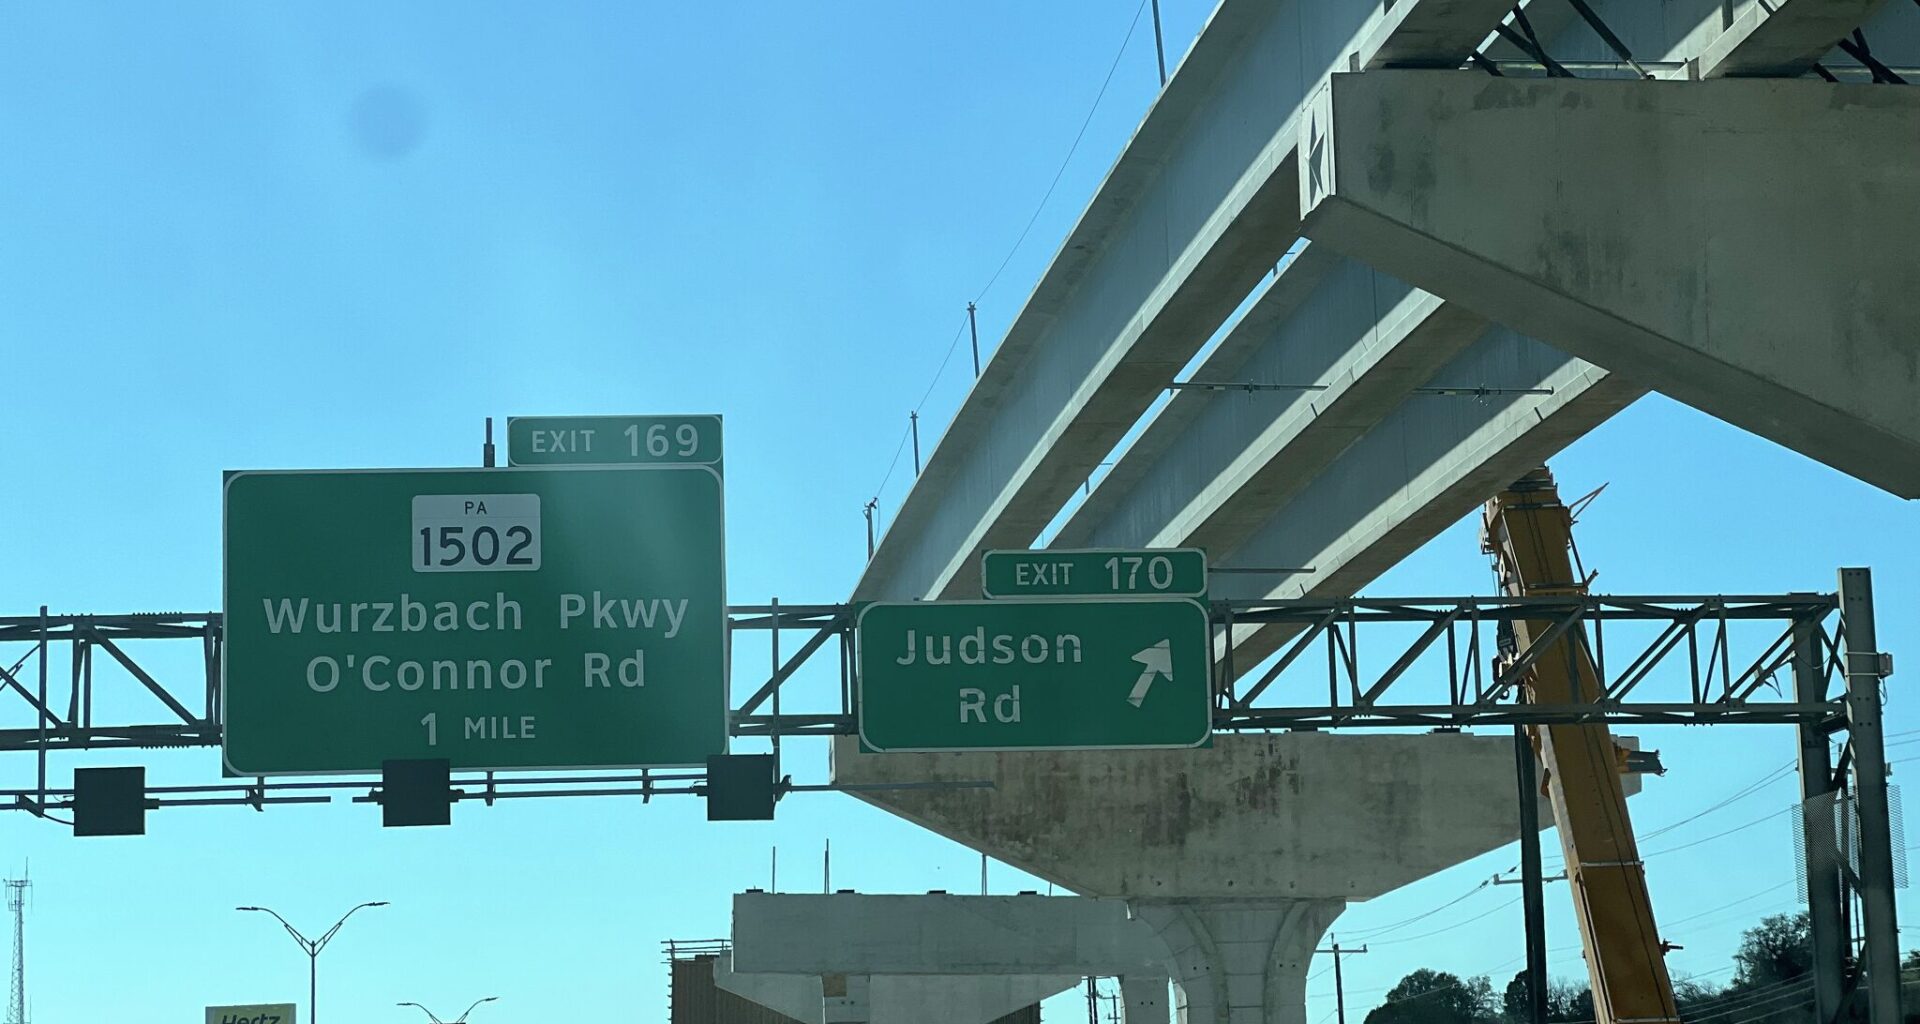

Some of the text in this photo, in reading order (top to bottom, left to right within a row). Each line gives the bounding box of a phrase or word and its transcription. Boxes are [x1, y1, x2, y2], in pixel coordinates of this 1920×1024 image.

[531, 424, 699, 457] EXIT 169
[464, 501, 488, 516] PA
[420, 526, 533, 567] 1502
[1015, 556, 1174, 589] EXIT 170
[263, 590, 689, 638] Wurzbach Pkwy
[896, 626, 1082, 665] Judson
[306, 649, 646, 692] O'Connor Rd
[959, 685, 1021, 723] Rd
[420, 713, 537, 745] 1 MILE
